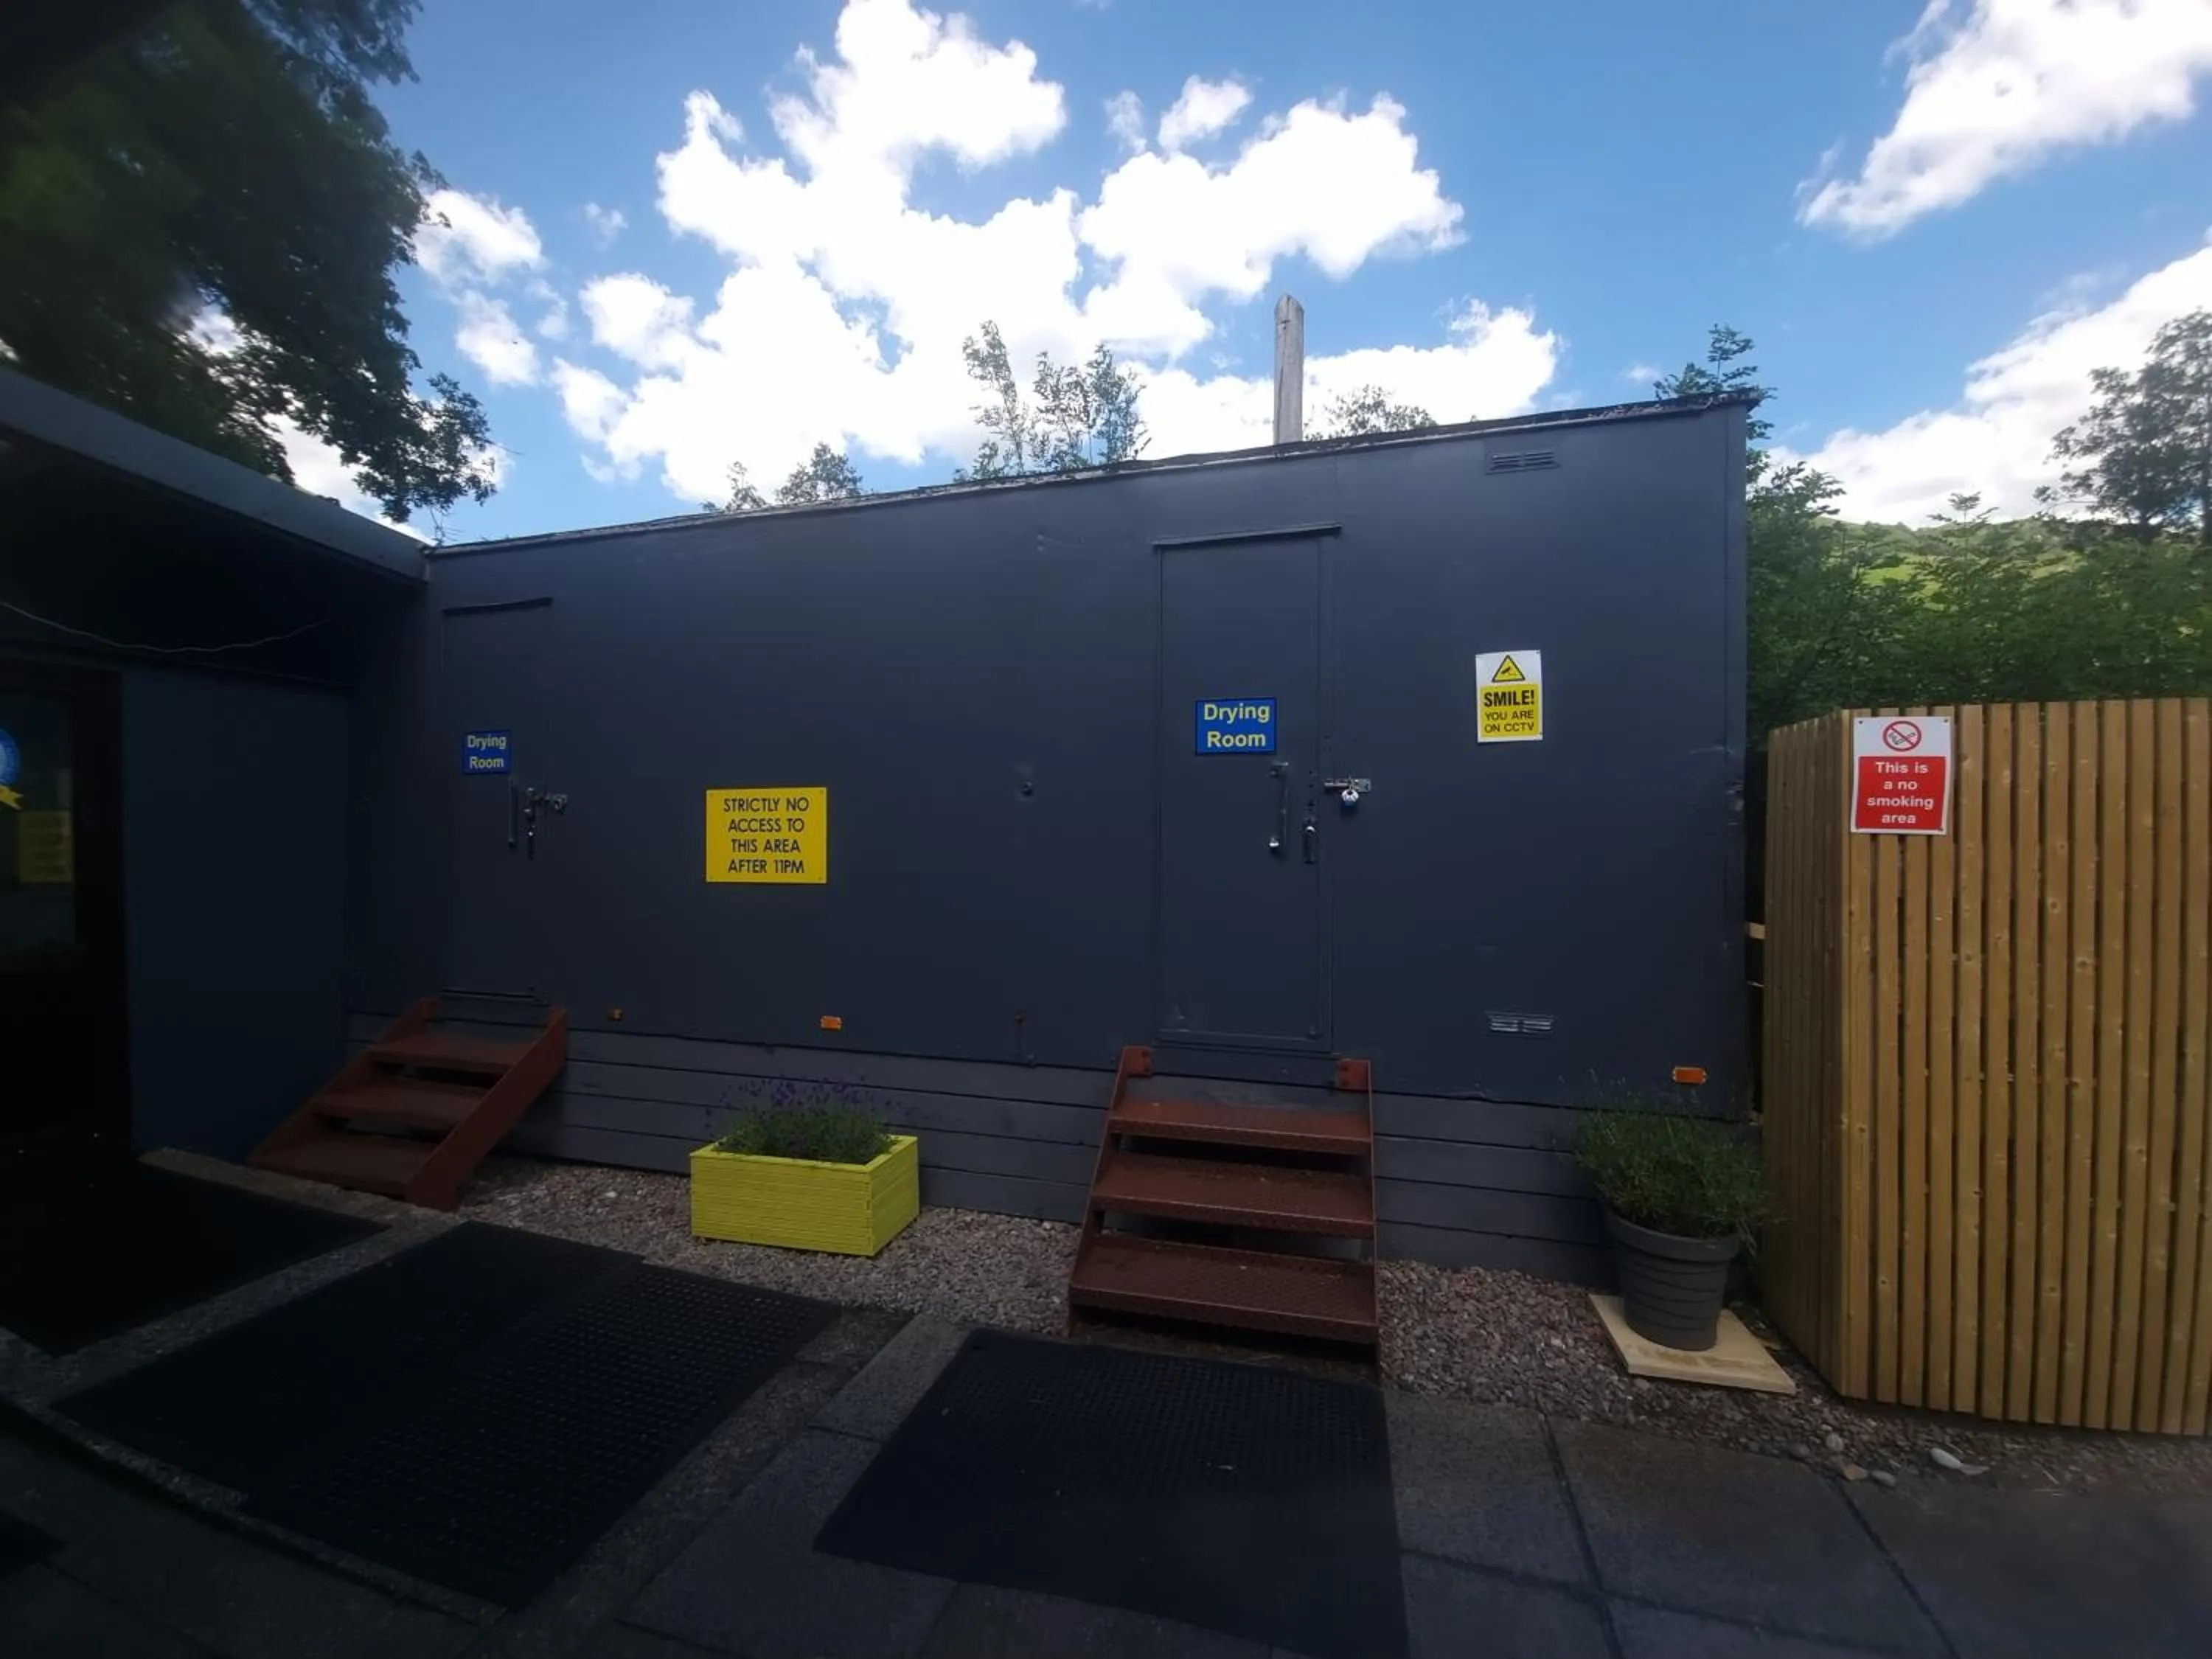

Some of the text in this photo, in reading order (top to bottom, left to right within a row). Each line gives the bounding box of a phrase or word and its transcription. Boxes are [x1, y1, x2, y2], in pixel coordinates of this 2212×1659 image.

[1484, 690, 1534, 707] SMILE!
[1204, 703, 1270, 724] Drying
[1485, 710, 1534, 720] YOU ARE
[1484, 723, 1534, 733] ON CCTV
[467, 734, 507, 750] Drying
[1207, 731, 1266, 748] Room
[470, 756, 504, 768] Room
[1876, 762, 1928, 773] This is
[1884, 781, 1917, 790] a no
[723, 797, 809, 812] STRICTLY NO
[1867, 796, 1934, 810] smoking
[728, 818, 804, 832] ACCESS TO
[1882, 815, 1916, 824] area
[731, 838, 801, 852] THIS AREA
[728, 859, 804, 873] AFTER 11PM
